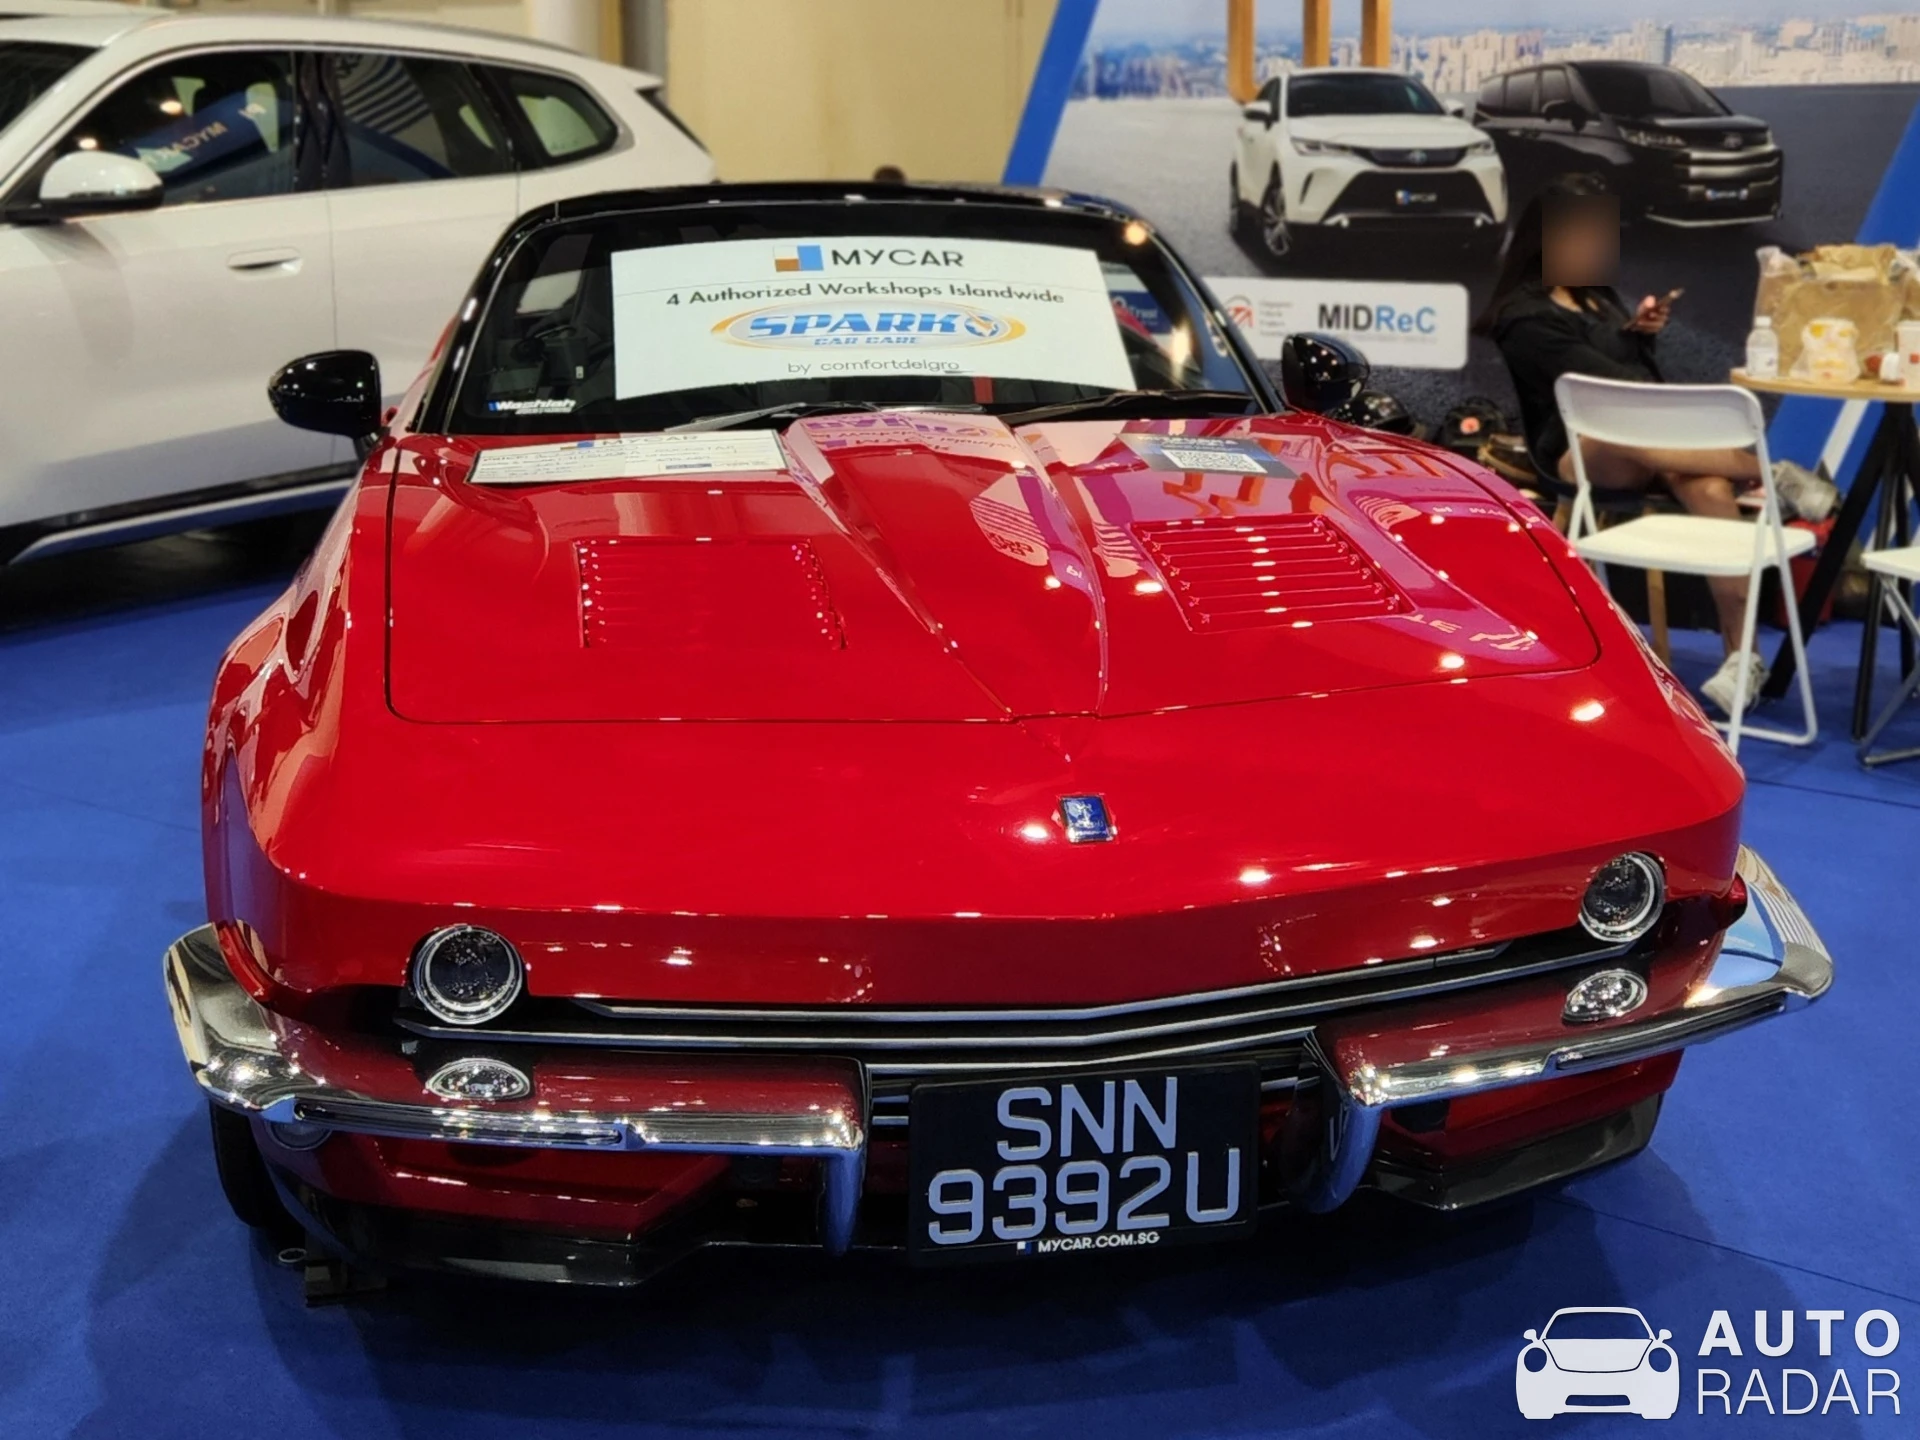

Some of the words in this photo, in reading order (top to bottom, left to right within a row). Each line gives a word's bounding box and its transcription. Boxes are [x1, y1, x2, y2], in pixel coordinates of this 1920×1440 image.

[831, 249, 964, 267] MYCAR
[666, 293, 680, 305] 4
[689, 283, 811, 304] Authorized
[818, 282, 942, 298] Workshops
[949, 284, 1064, 303] Islandwide
[750, 312, 961, 336] SPARK
[1318, 304, 1436, 334] MIDReC
[814, 336, 859, 346] CAR
[865, 336, 922, 345] CARE
[788, 362, 811, 374] by
[820, 359, 960, 372] comfortdelgro
[996, 1076, 1178, 1161] SNN
[928, 1148, 1241, 1245] 9392U
[1038, 1231, 1160, 1253] MYCAR.COM.SG
